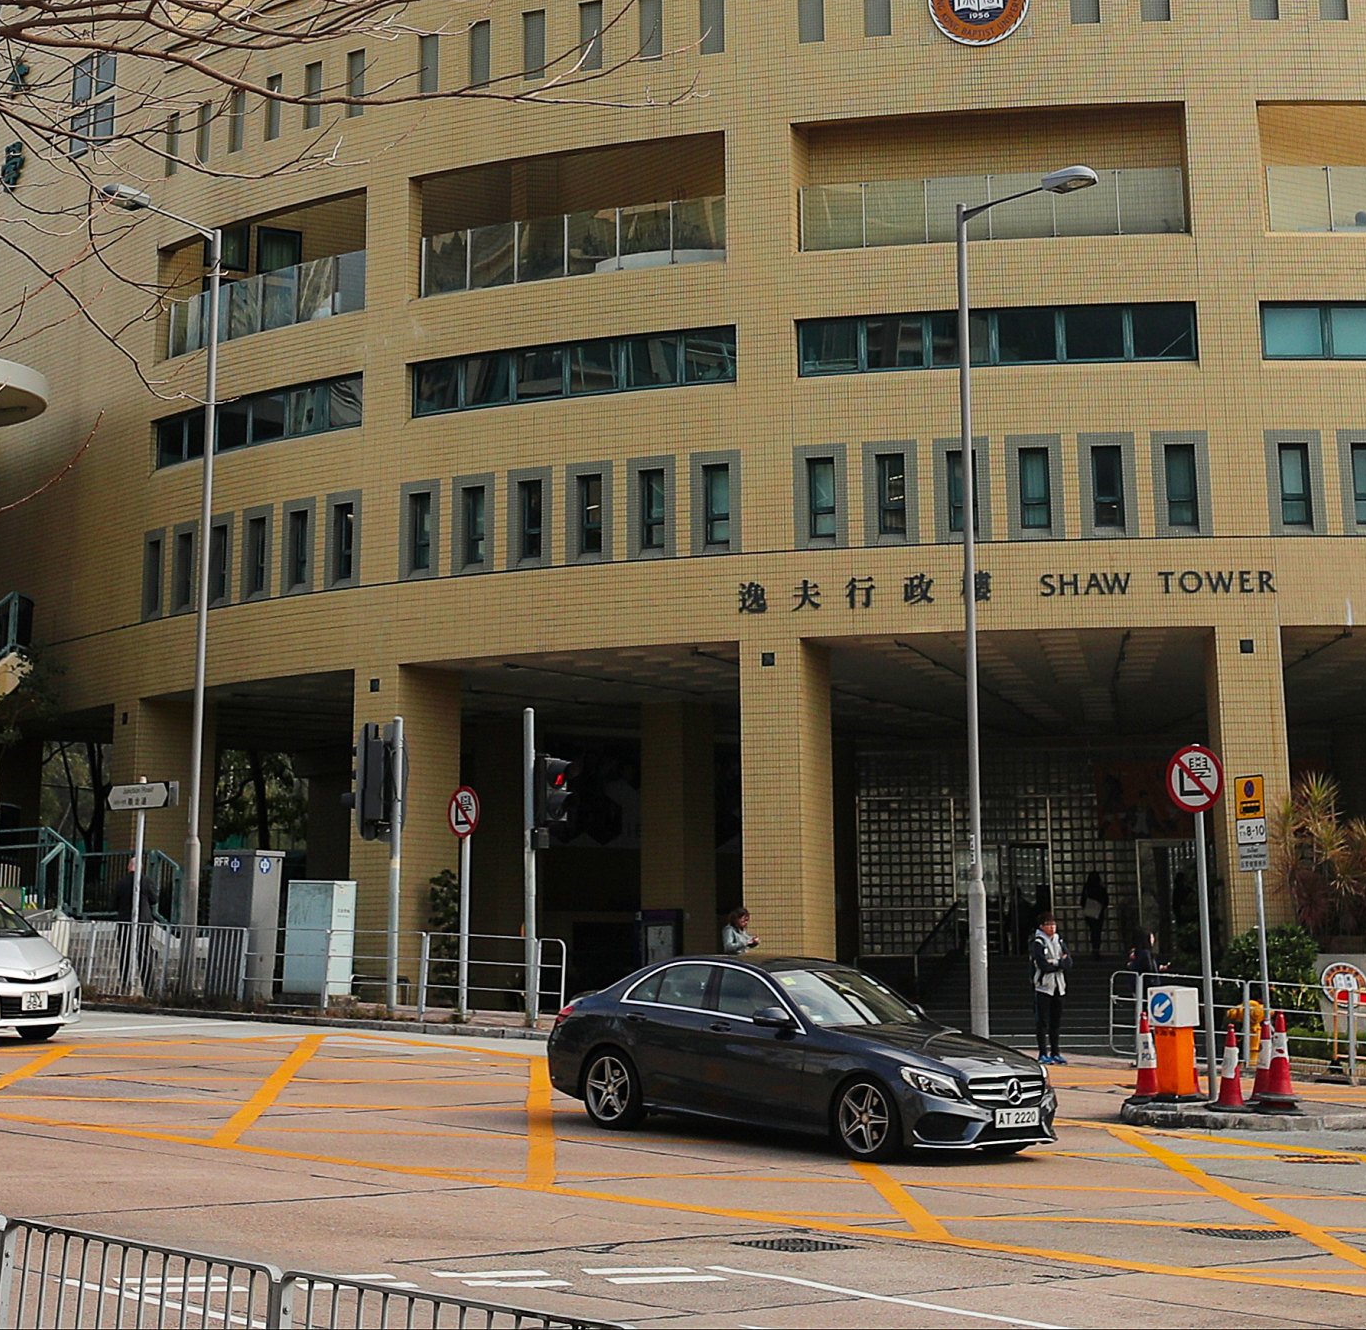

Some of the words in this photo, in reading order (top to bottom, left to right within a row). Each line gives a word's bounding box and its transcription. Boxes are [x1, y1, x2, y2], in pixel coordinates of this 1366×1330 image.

[968, 11, 990, 20] 1956
[1039, 572, 1131, 597] SHAW
[1157, 570, 1277, 594] TOWER
[1246, 824, 1265, 837] 8-10
[998, 1112, 1012, 1125] AT
[1014, 1110, 1037, 1124] 2220
